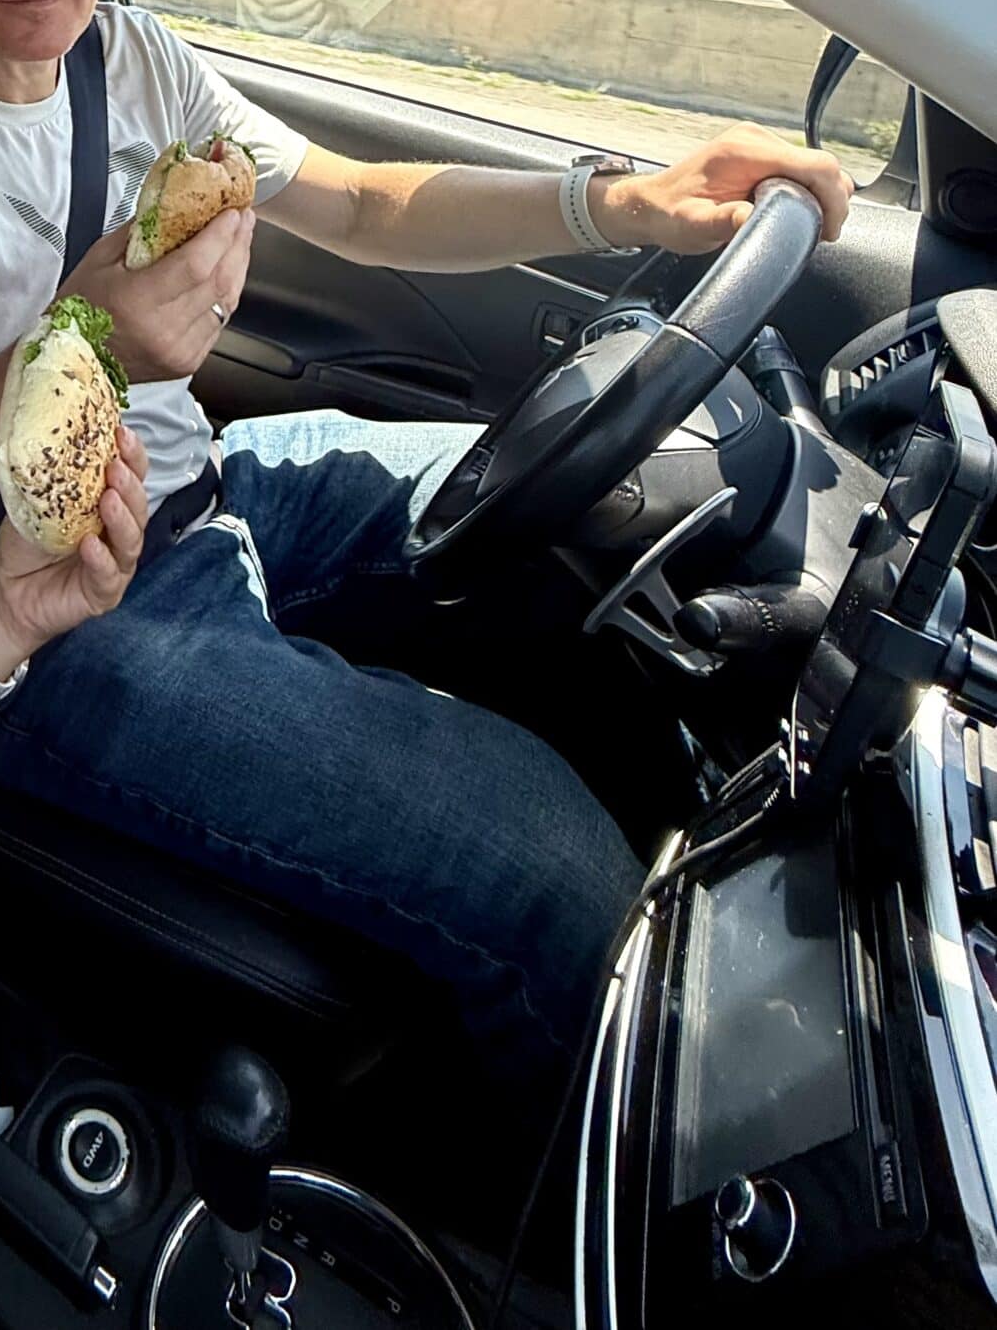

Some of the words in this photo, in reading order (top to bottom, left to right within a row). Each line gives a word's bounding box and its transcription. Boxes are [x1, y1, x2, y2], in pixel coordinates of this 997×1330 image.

[82, 1130, 105, 1169] 4WD
[292, 1231, 311, 1250] N
[320, 1250, 337, 1270] R
[386, 1296, 402, 1316] P
